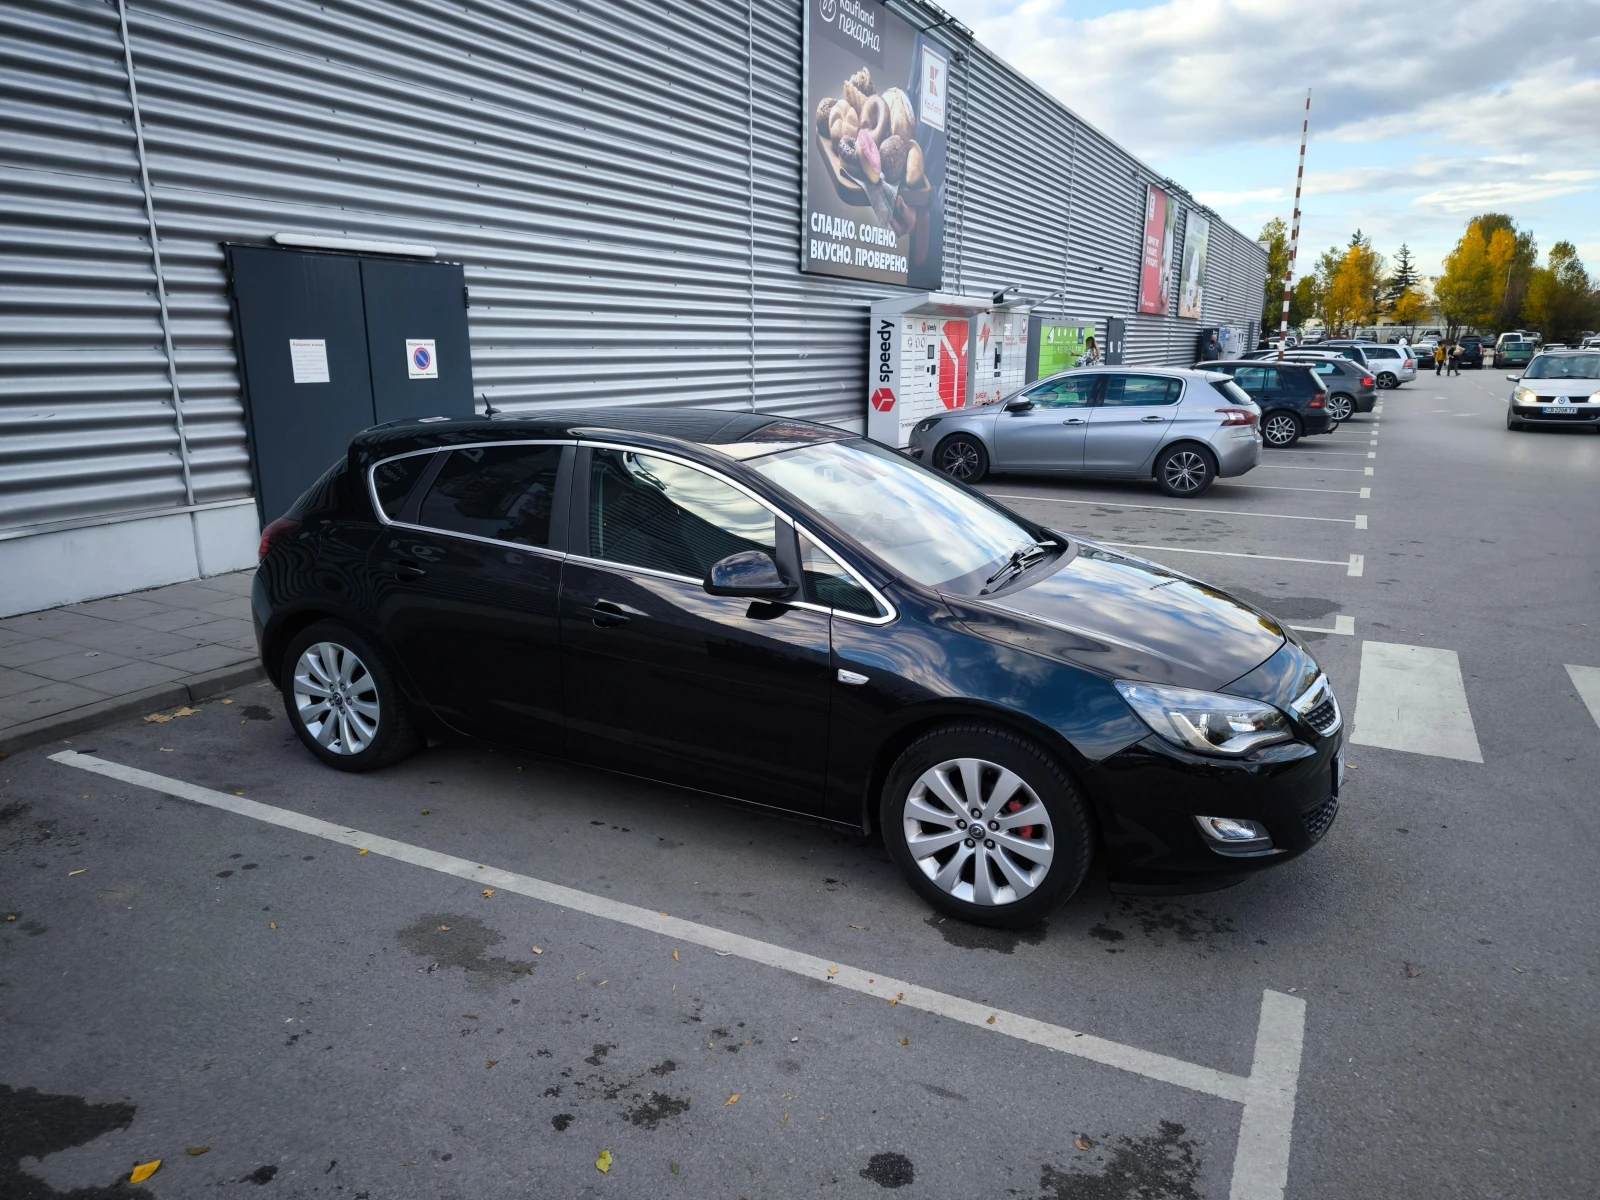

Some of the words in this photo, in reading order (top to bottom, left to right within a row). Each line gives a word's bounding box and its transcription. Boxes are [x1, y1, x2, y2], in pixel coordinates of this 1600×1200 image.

[838, 12, 881, 53] пекарна
[839, 0, 875, 28] Kaufland
[810, 211, 858, 241] СЛАДКО.
[858, 223, 898, 250] СОЛЕНО.
[810, 239, 853, 265] ВКУСНО.
[854, 248, 909, 275] ПРОВЕРЕНО.
[876, 319, 895, 383] speedy
